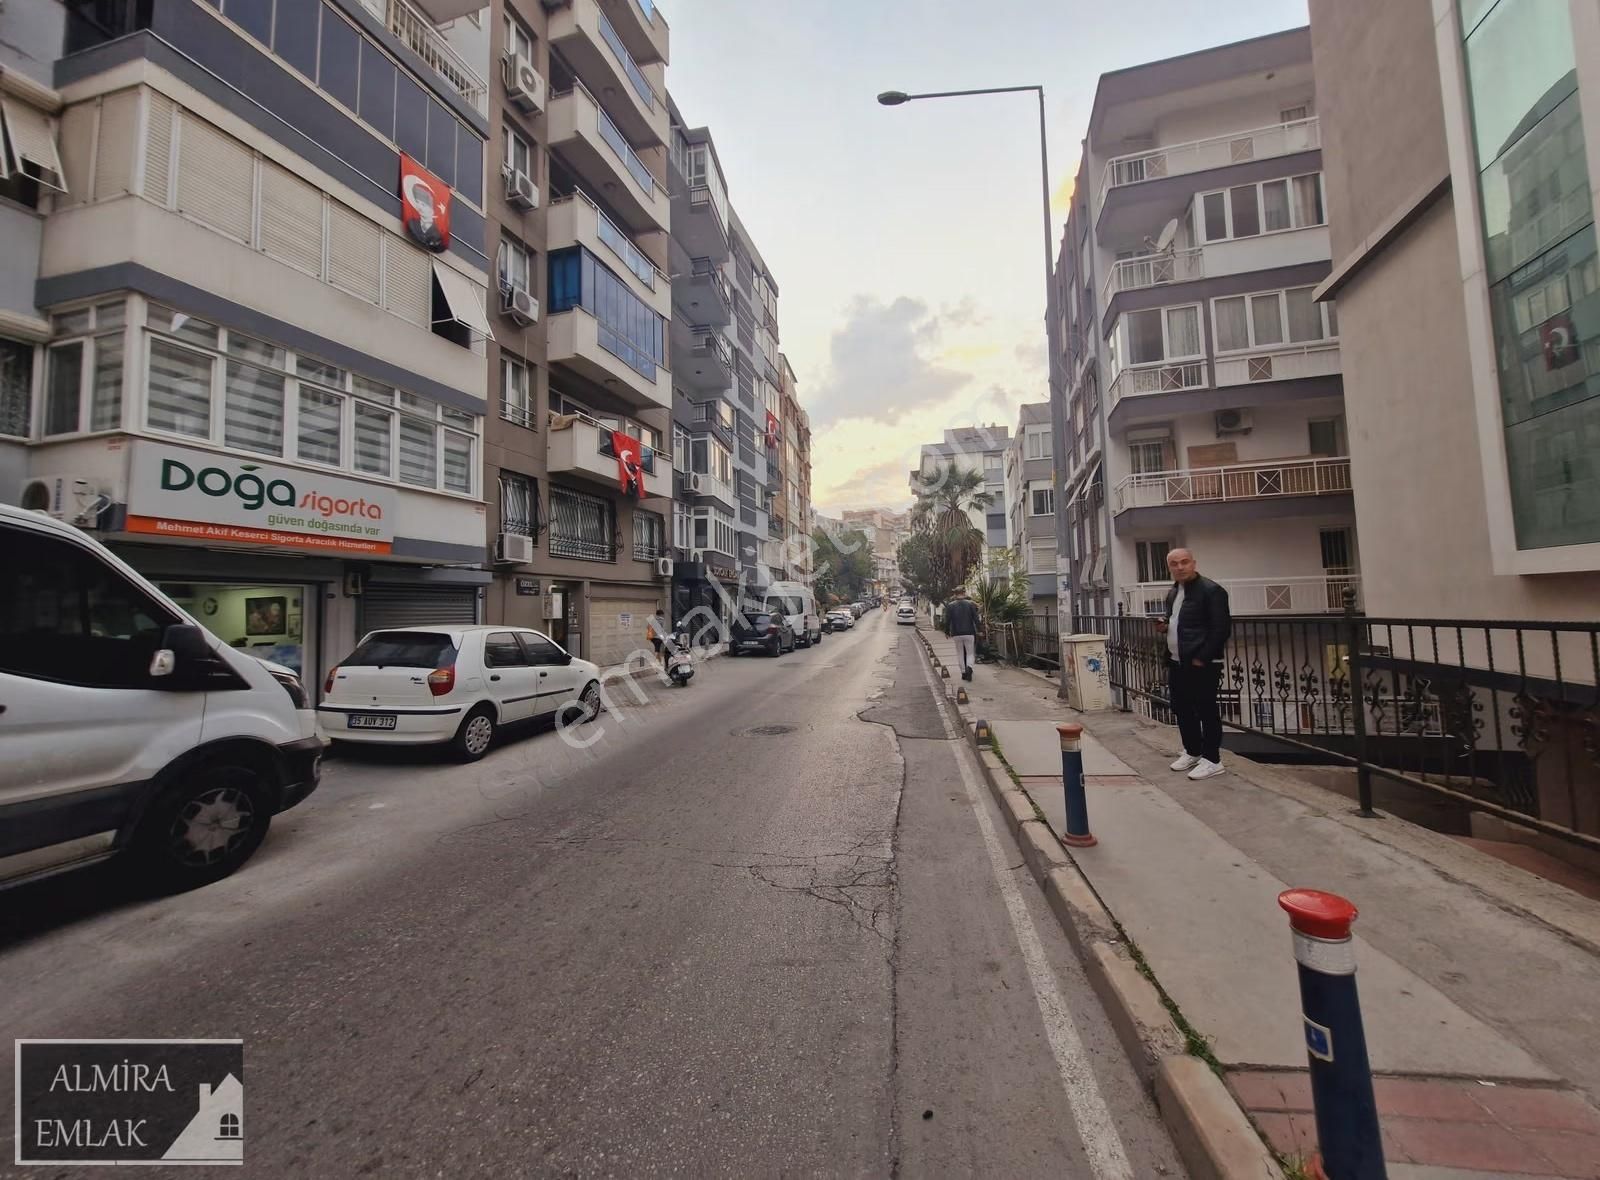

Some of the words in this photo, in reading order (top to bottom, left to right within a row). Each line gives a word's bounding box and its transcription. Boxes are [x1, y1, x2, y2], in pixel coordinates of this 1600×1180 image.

[161, 458, 296, 511] Doğa
[298, 491, 383, 520] sigorta
[156, 521, 205, 534] Mehmet
[207, 526, 228, 536] Akif
[231, 529, 269, 540] Keserci
[271, 533, 304, 543] Sigorta
[305, 536, 337, 546] Aracılık
[338, 540, 377, 550] Hizmetleri
[267, 513, 305, 526] güven
[307, 518, 363, 533] doğasında
[366, 526, 381, 536] var
[379, 717, 394, 727] 312
